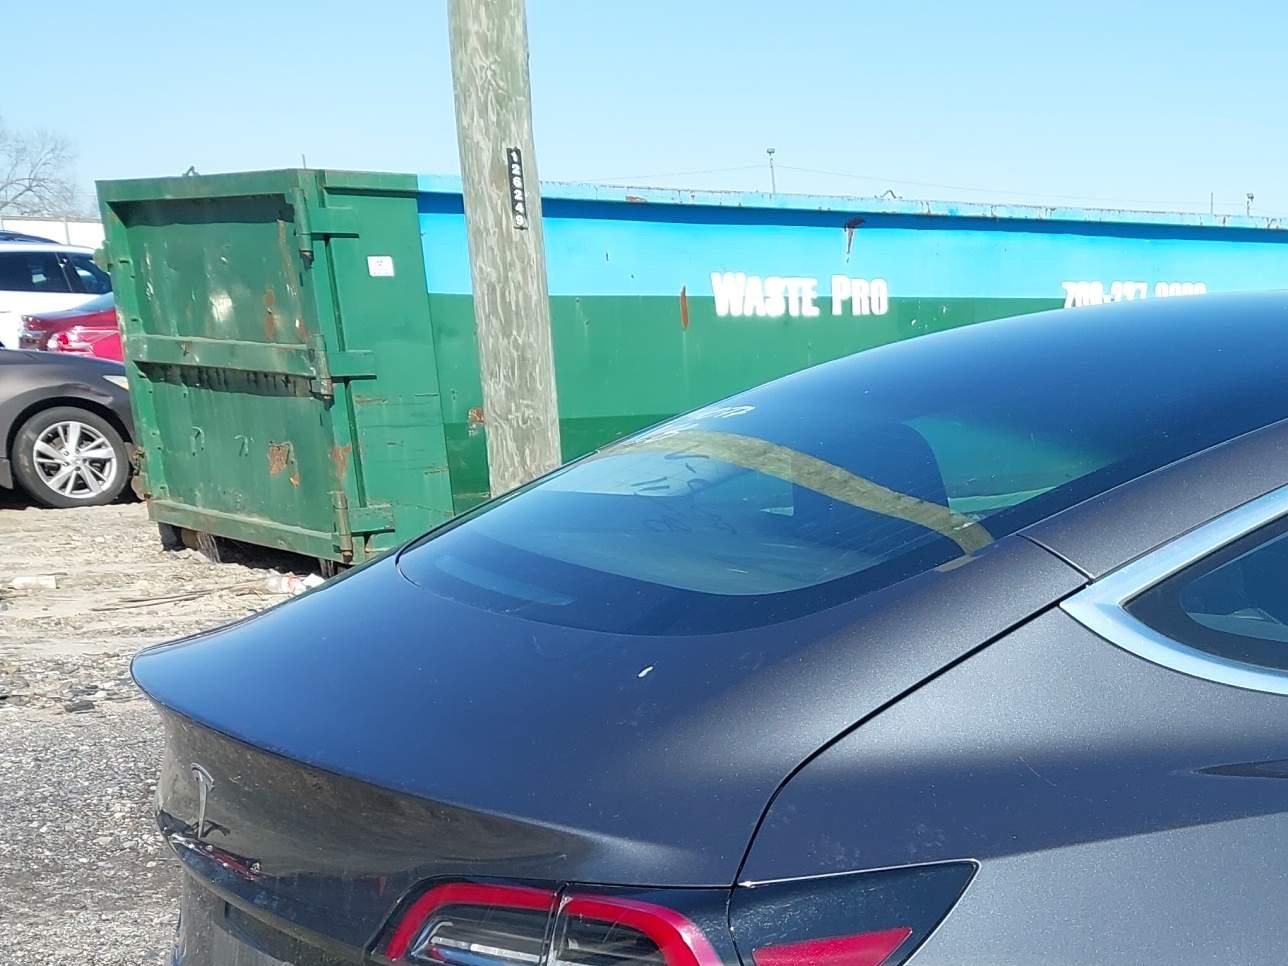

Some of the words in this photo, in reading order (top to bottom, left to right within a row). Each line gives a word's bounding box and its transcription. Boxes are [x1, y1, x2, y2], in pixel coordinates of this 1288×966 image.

[511, 151, 524, 226] 126249
[711, 272, 820, 317] WASTE
[832, 274, 888, 316] PRO
